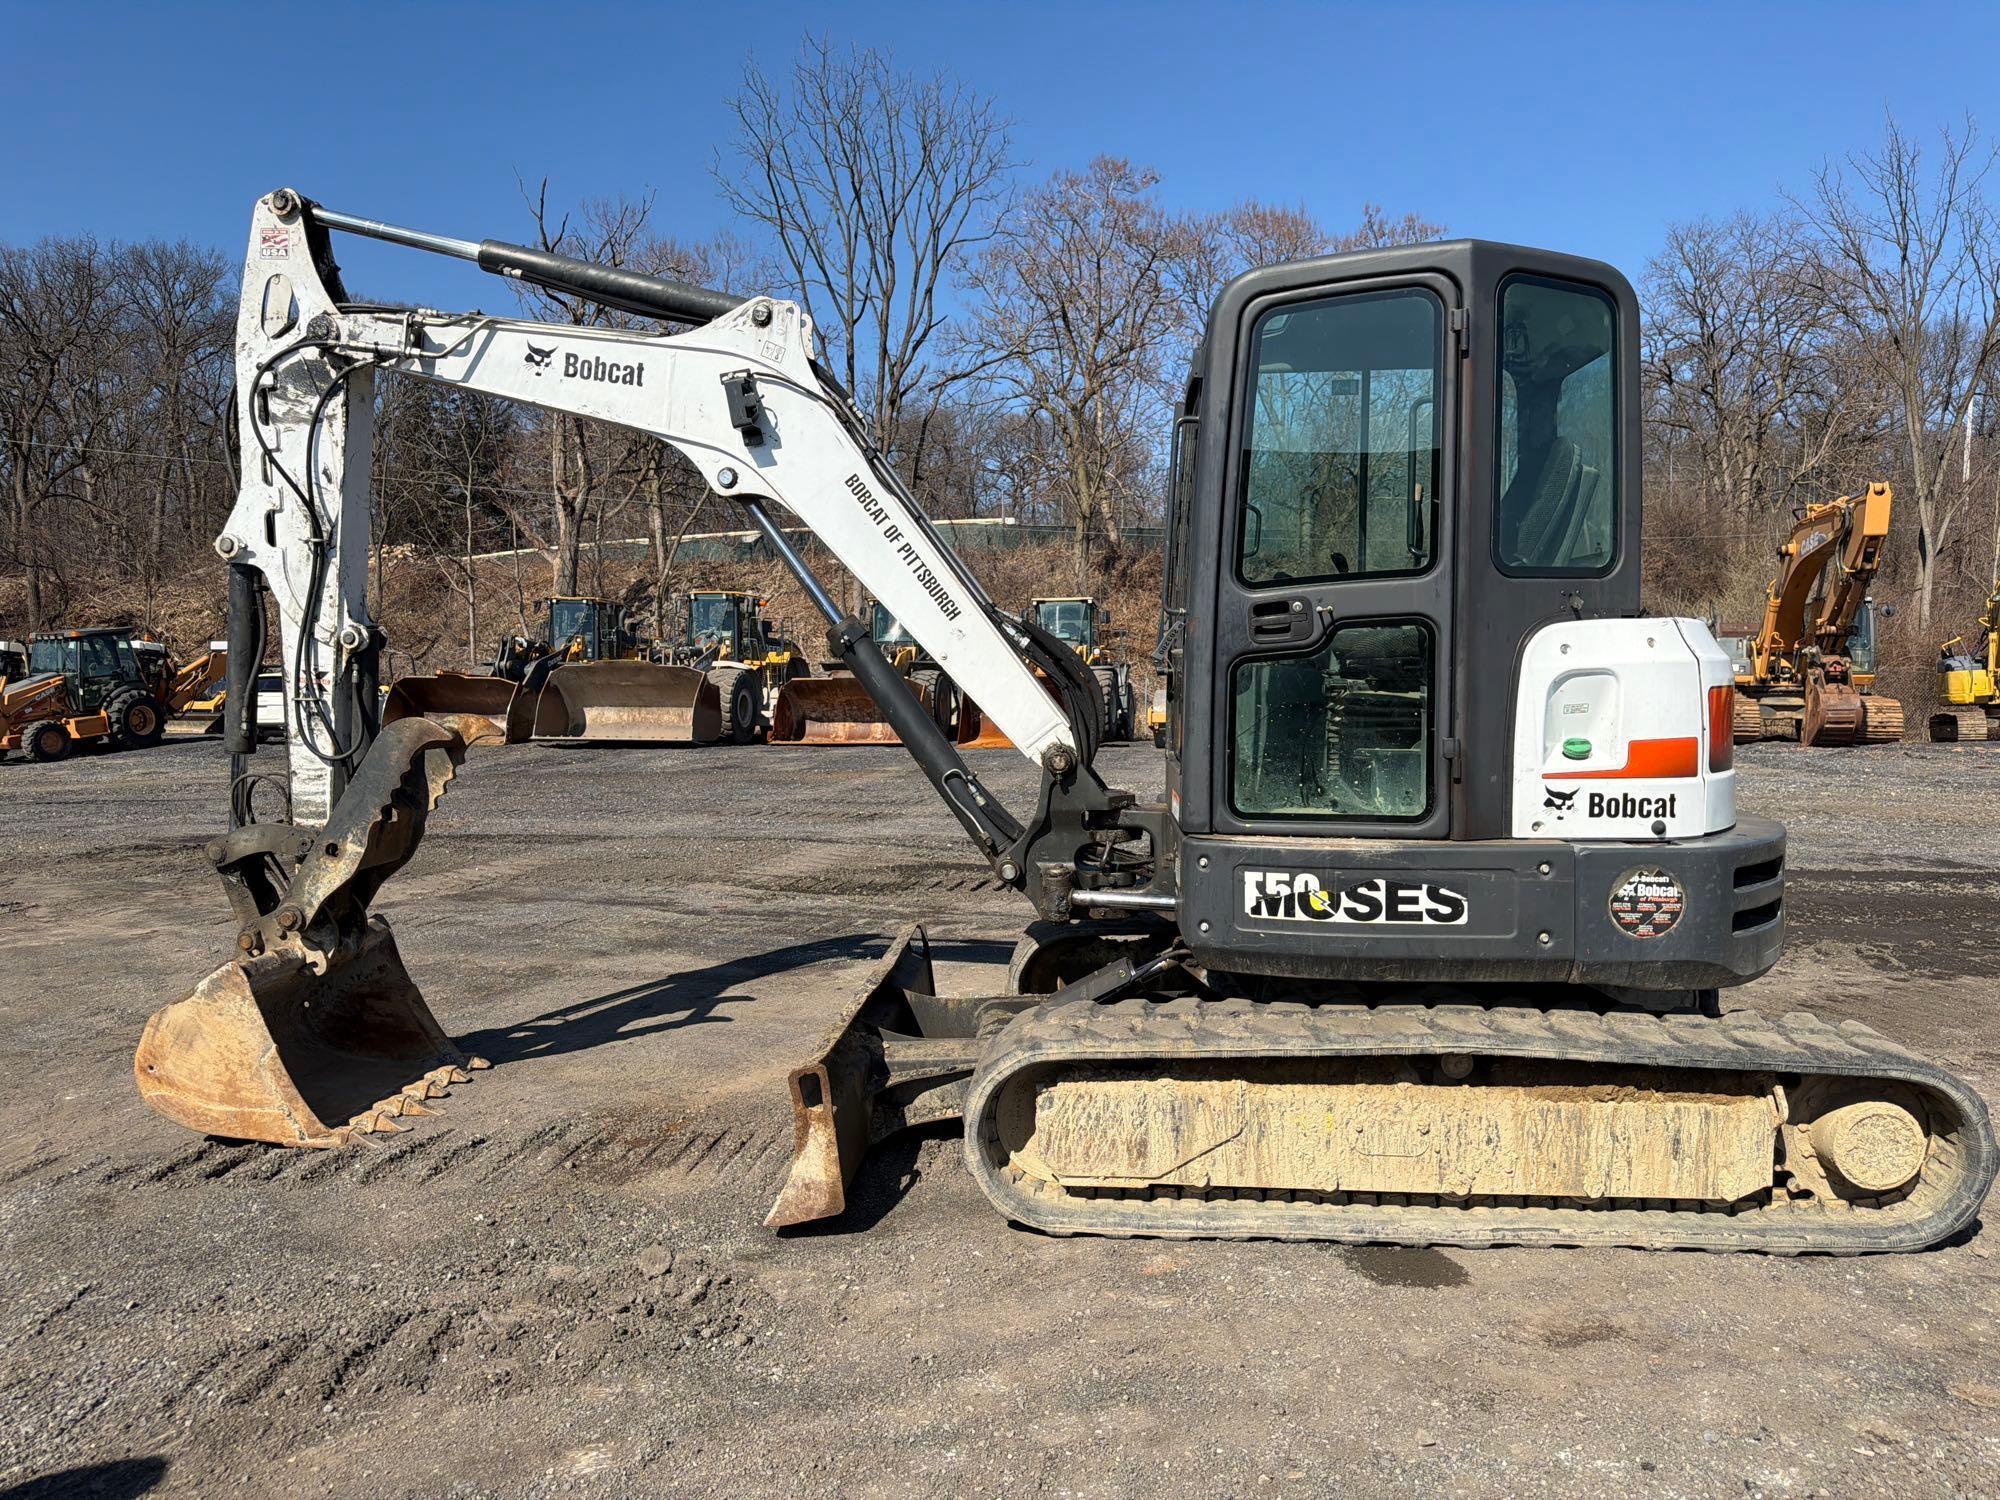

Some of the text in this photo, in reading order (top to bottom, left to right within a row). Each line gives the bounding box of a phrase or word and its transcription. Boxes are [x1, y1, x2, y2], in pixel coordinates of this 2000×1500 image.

[262, 248, 287, 256] USA
[563, 352, 645, 387] Bobcat
[844, 473, 962, 621] BOBCAT OF PITTSBURGH
[1588, 792, 1676, 818] Bobcat
